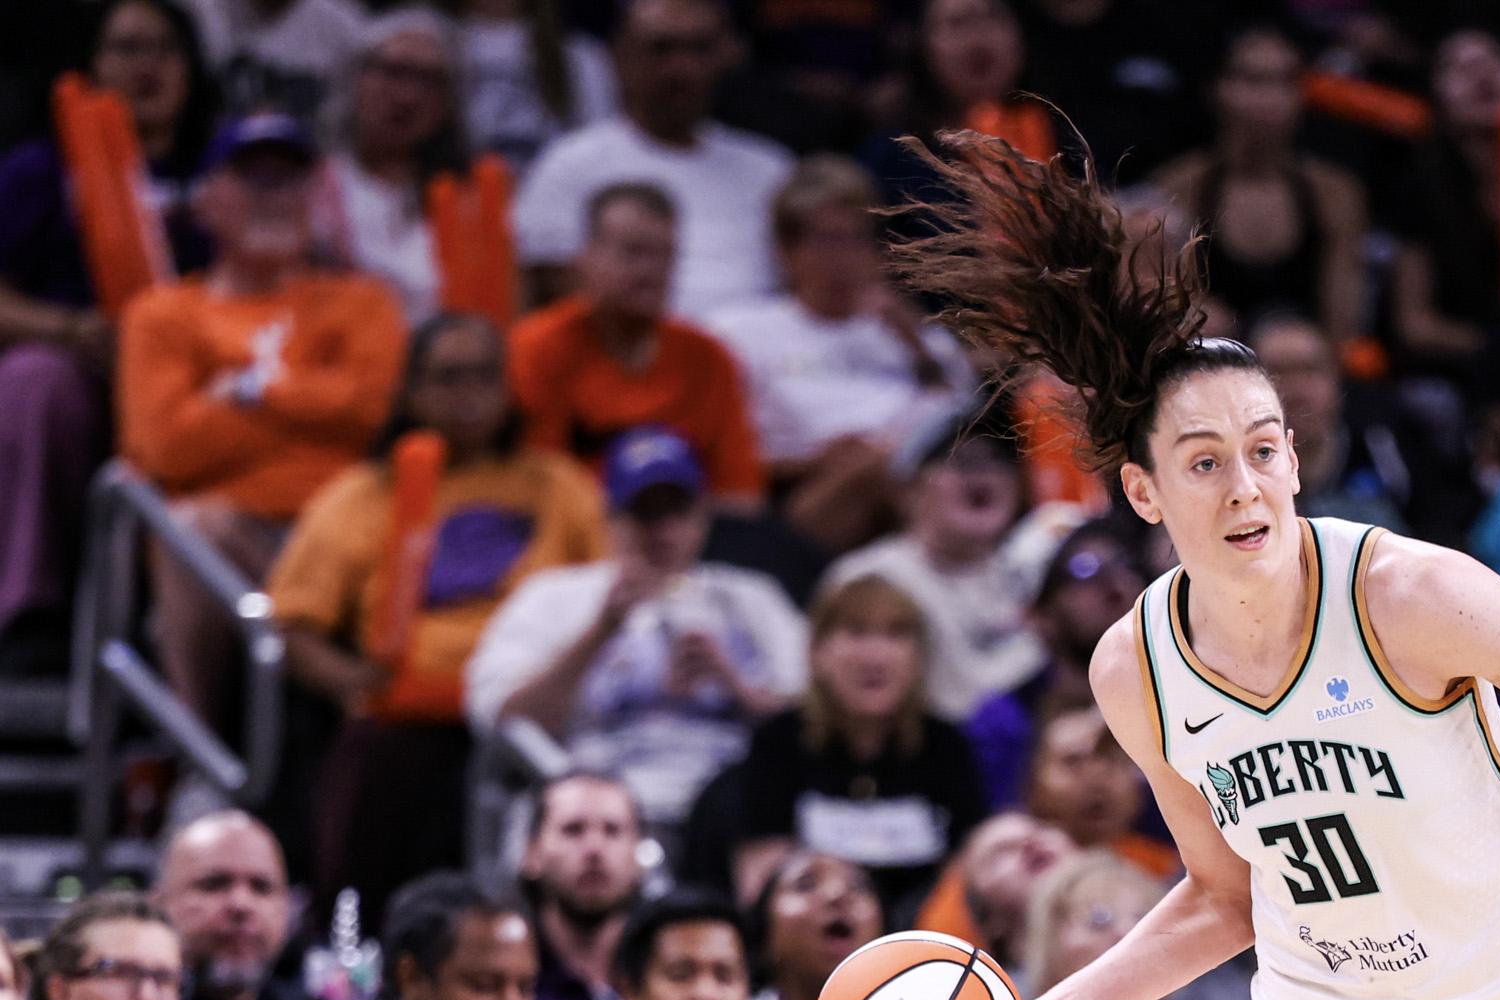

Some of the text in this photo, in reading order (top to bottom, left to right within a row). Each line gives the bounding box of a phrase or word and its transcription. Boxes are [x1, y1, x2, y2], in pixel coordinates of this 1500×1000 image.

[1316, 698, 1374, 722] BARCLAYS
[1257, 812, 1380, 905] 30
[1349, 929, 1416, 954] Liberty
[1359, 942, 1429, 972] Mutual
